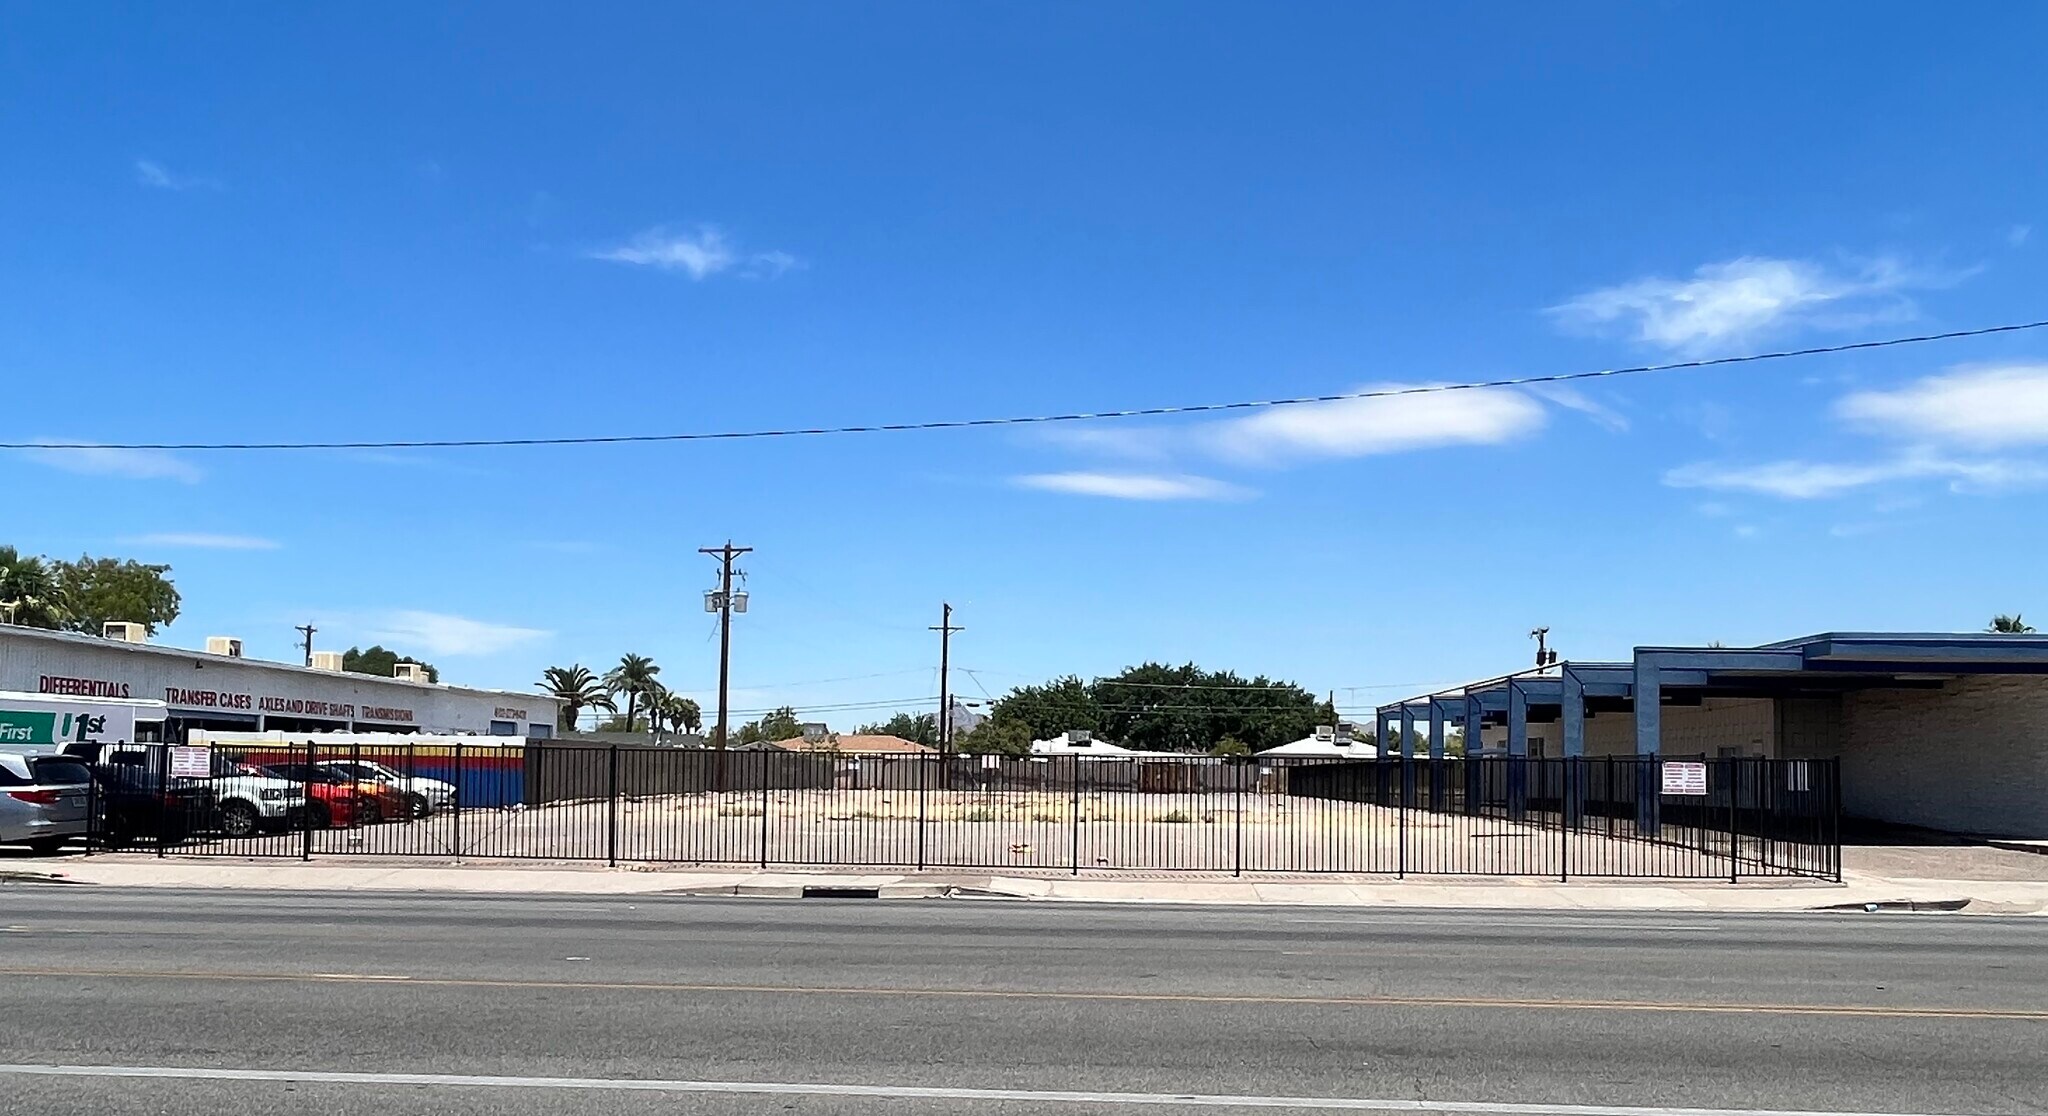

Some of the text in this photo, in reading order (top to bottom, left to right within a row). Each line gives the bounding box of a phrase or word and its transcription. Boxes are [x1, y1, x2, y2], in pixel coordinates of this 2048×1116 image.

[40, 675, 129, 698] DIFFERENTIALS
[166, 687, 252, 710] TRANSFER CASES
[259, 697, 354, 718] AXLES AND DRIVE SHAFTS
[361, 705, 413, 722] TRANSMISSIONS
[0, 723, 34, 740] First
